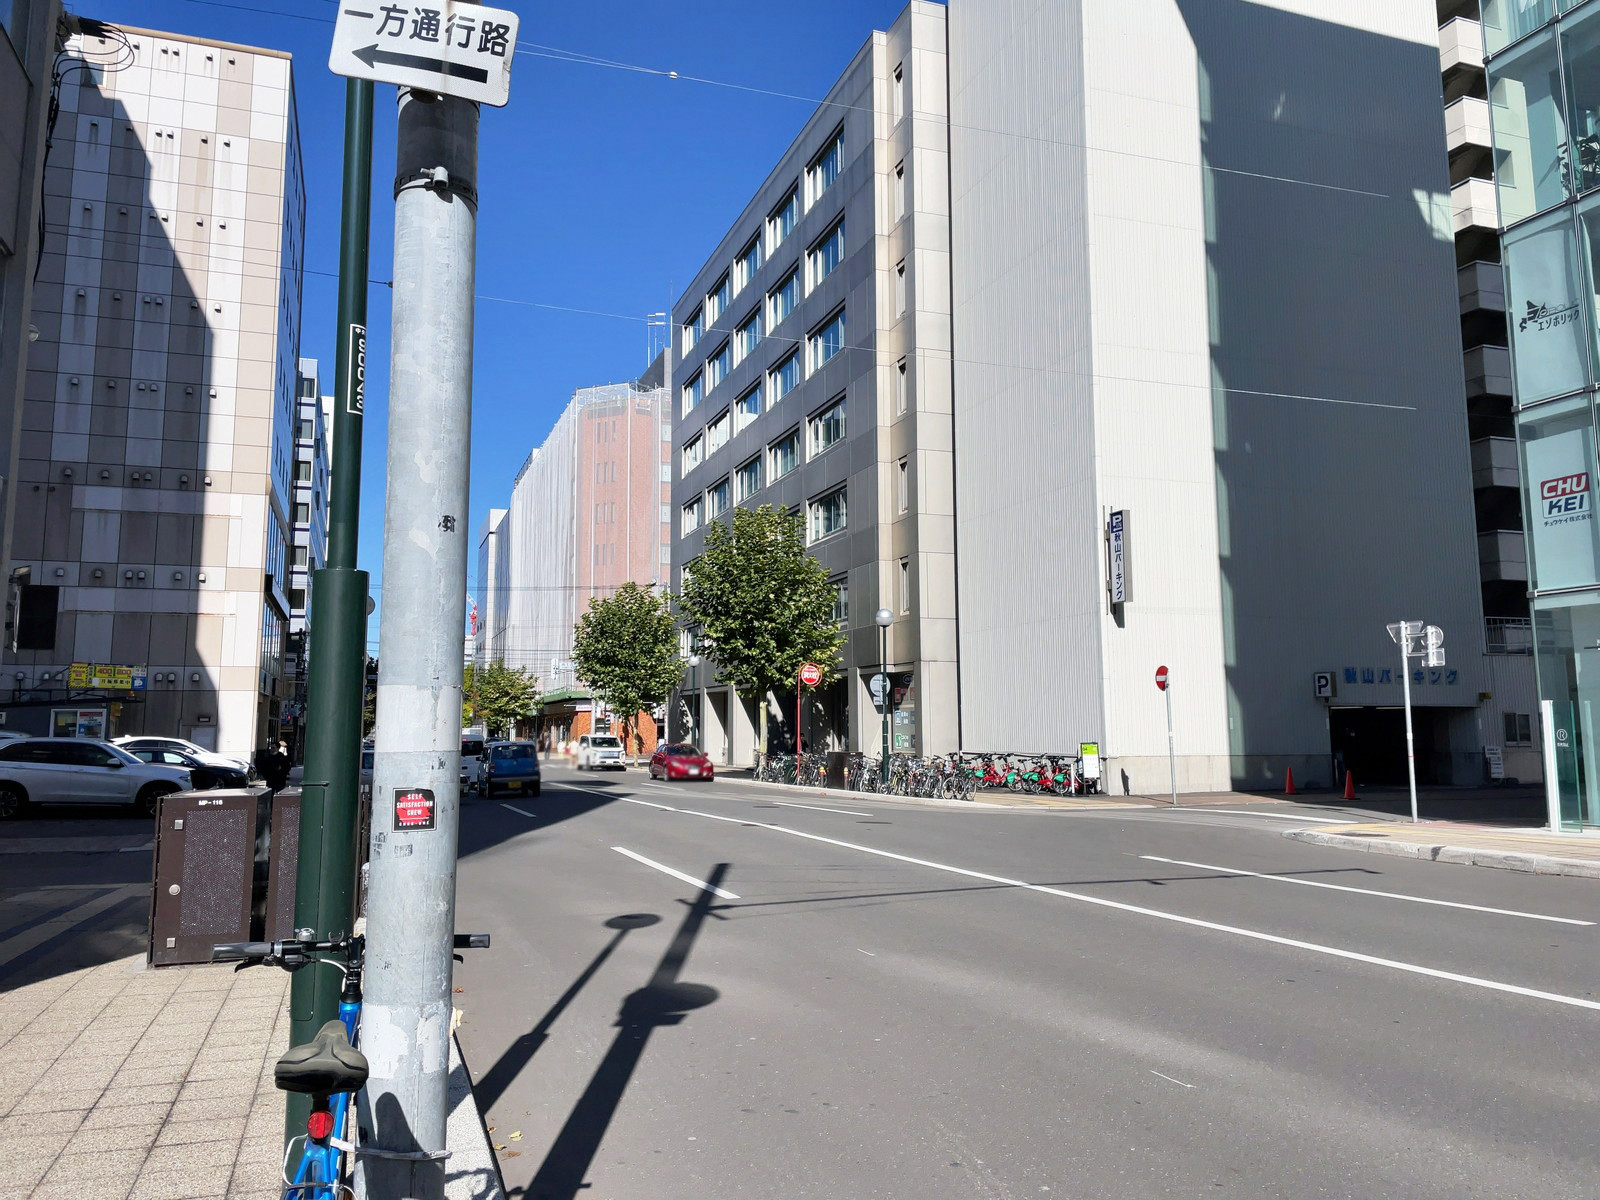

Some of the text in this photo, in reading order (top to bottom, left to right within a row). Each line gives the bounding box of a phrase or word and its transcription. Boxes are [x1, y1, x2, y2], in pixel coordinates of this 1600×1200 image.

[344, 3, 510, 57] 一方通行路
[1543, 474, 1587, 498] CHU
[1548, 494, 1584, 515] KEI
[1317, 675, 1329, 695] P
[396, 800, 433, 808] SATISFACTION
